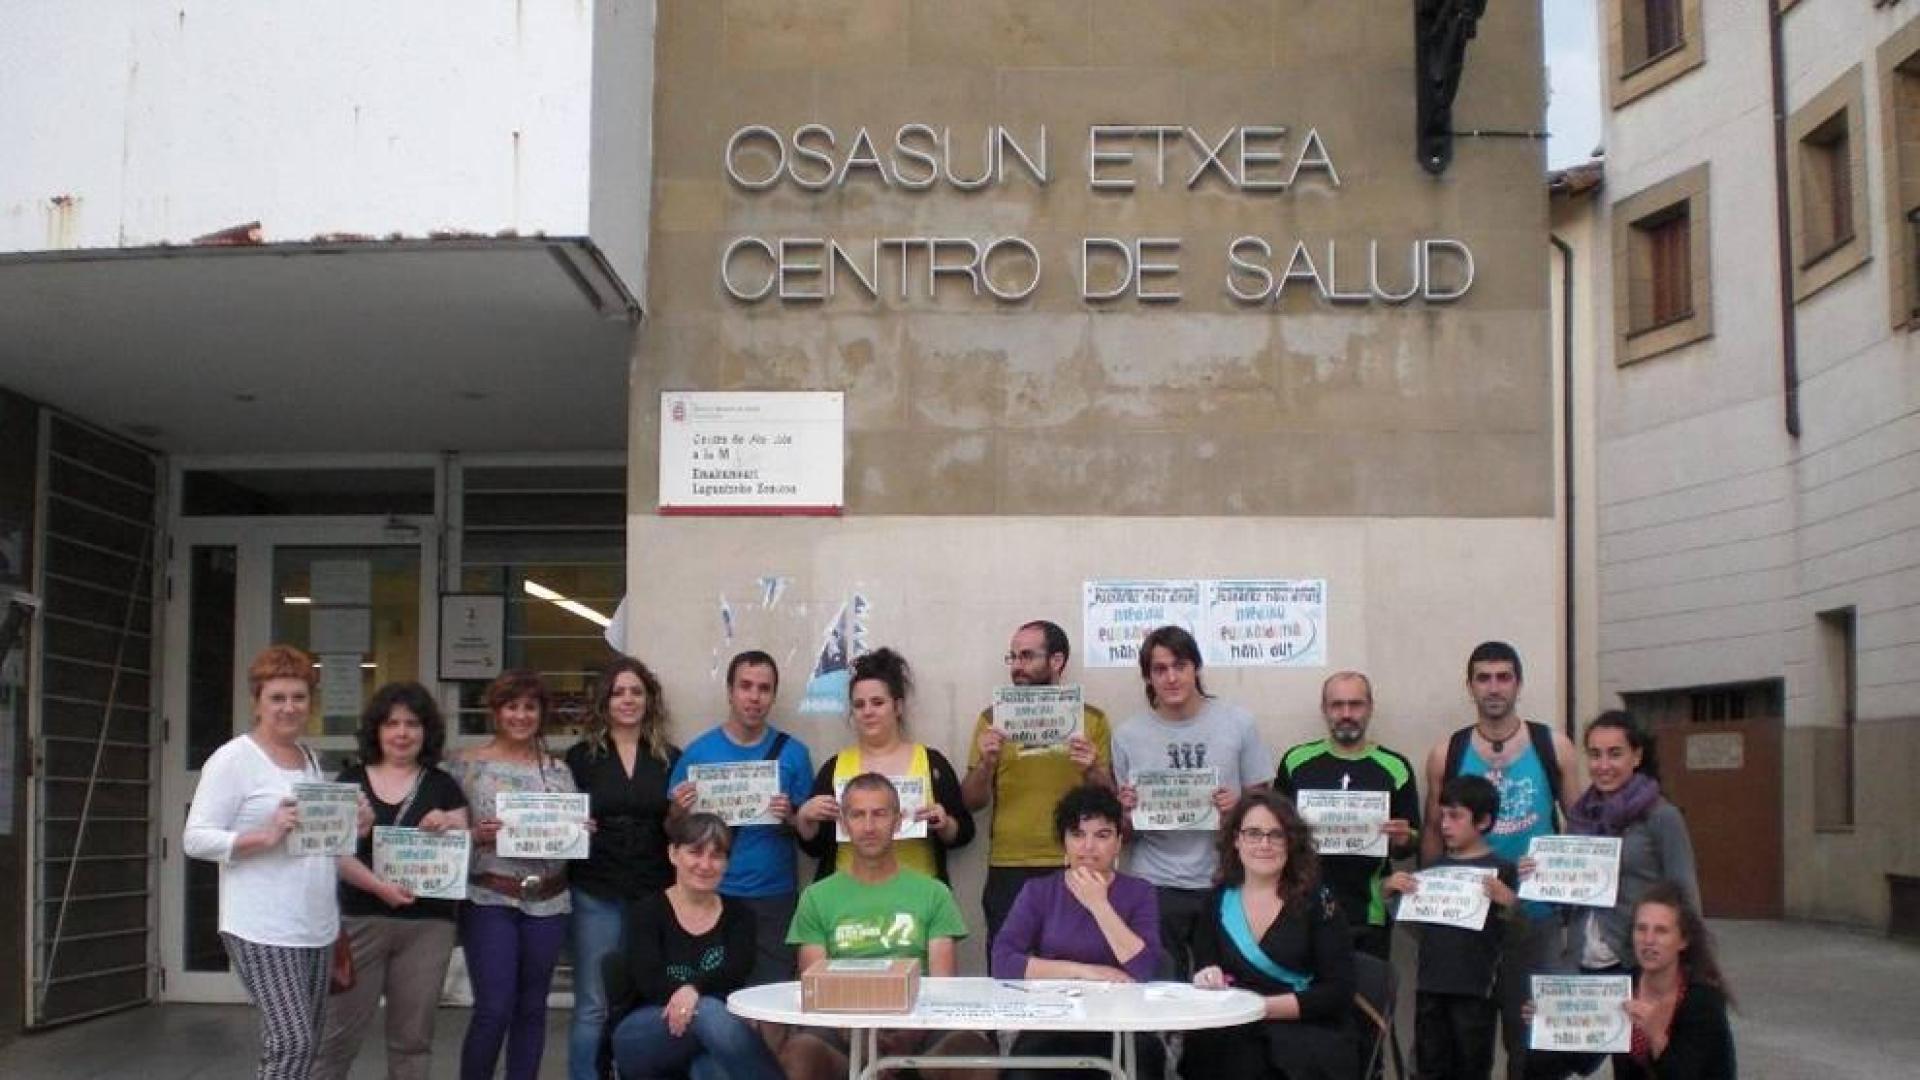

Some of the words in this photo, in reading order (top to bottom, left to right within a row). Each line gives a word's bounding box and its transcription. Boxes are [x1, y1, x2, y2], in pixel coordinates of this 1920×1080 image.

[724, 122, 1048, 190] OSASUN
[1088, 124, 1342, 192] ETXEA
[721, 235, 1042, 302] CENTRO
[1082, 236, 1182, 302] DE
[1226, 235, 1476, 303] SALUD
